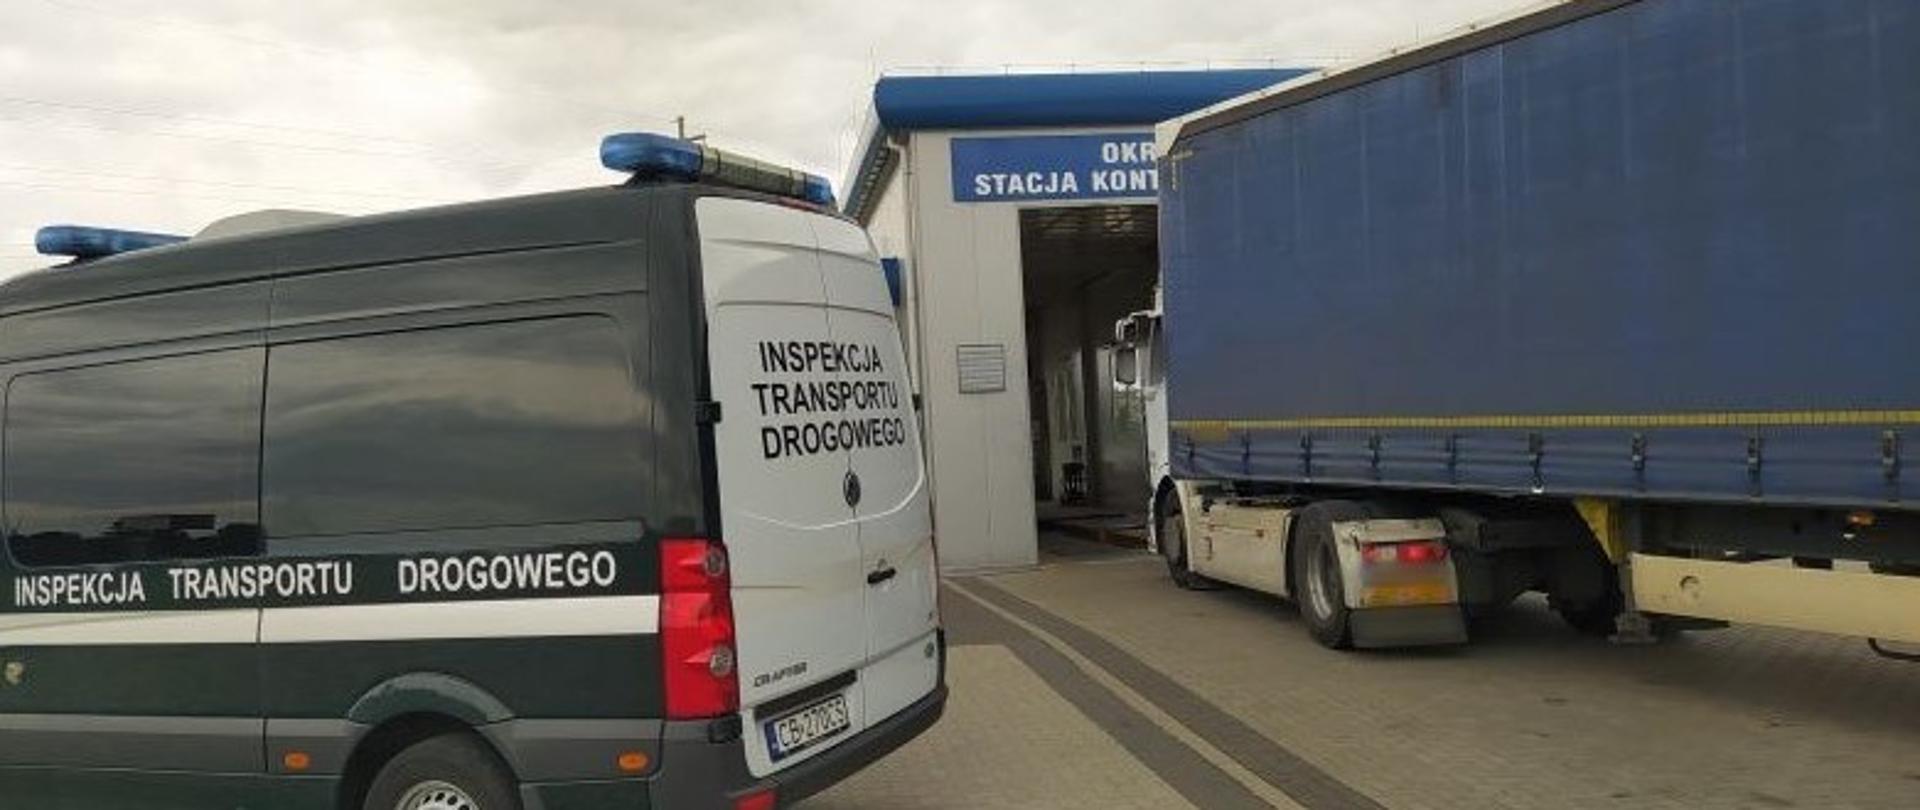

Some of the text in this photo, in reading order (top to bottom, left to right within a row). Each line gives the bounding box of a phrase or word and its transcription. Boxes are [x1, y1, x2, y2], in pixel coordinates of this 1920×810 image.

[1102, 142, 1156, 164] OKR
[975, 169, 1158, 196] STACJA KONT
[759, 341, 884, 373] INSPEKCJA
[752, 381, 898, 416] TRANSPORTU
[762, 418, 905, 460] DROGOWEGO
[14, 551, 617, 607] INSPEKCJA TRANSPORTU DROGOWEGO
